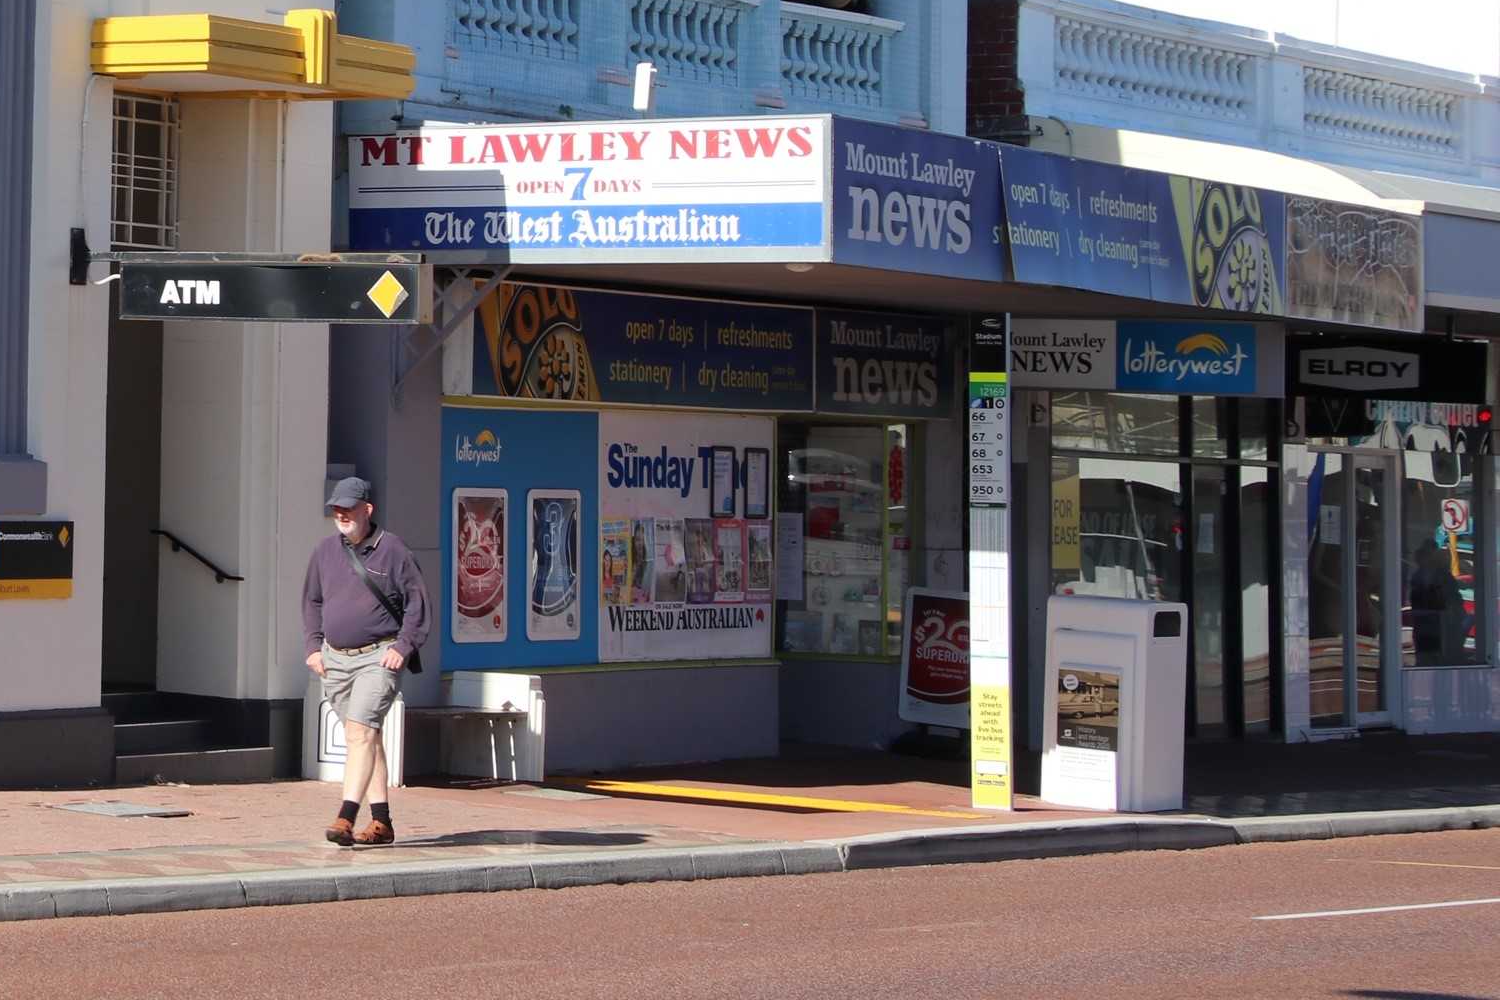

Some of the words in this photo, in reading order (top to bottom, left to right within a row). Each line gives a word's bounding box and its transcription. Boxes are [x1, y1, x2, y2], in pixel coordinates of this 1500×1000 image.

[360, 136, 431, 167] MT
[448, 131, 651, 165] LAWLEY
[668, 125, 813, 160] NEWS
[516, 179, 564, 194] OPEN
[564, 167, 594, 201] 7
[593, 179, 642, 194] DAYS
[845, 141, 908, 179] Mount
[910, 152, 976, 198] Lawley
[1011, 183, 1038, 208] open
[1039, 183, 1047, 202] 7
[1049, 186, 1070, 215] days
[1089, 191, 1158, 224] refreshments
[424, 210, 476, 245] The
[484, 210, 564, 244] West
[568, 208, 741, 247] Australian
[847, 185, 972, 255] news
[992, 222, 1060, 256] stationery
[1078, 230, 1095, 262] dry
[1096, 233, 1139, 269] cleaning
[159, 279, 221, 305] ATM
[625, 321, 654, 344] open
[658, 319, 666, 340] 7
[668, 319, 694, 348] days
[717, 321, 793, 350] refreshments
[830, 320, 883, 348] Mount
[885, 325, 941, 357] Lawley
[1010, 333, 1047, 347] ount
[1052, 332, 1106, 352] Lawley
[1011, 350, 1092, 375] NEWS
[1124, 338, 1249, 381] lotterywest
[1307, 358, 1411, 378] ELROY
[609, 358, 672, 390] stationery
[698, 361, 717, 392] dry
[720, 363, 770, 395] cleaning
[833, 356, 938, 408] news
[971, 412, 986, 421] 66
[455, 433, 502, 467] lotterywest
[624, 443, 638, 454] The
[971, 433, 985, 442] 67
[971, 449, 986, 458] 68
[607, 443, 695, 498] Sunday
[971, 465, 993, 474] 653
[971, 486, 994, 495] 950
[1053, 499, 1073, 517] FOR
[1052, 526, 1078, 545] EASE
[608, 605, 674, 632] WEEKEND
[676, 606, 754, 631] AUSTRALIAN
[982, 693, 998, 701] Stay
